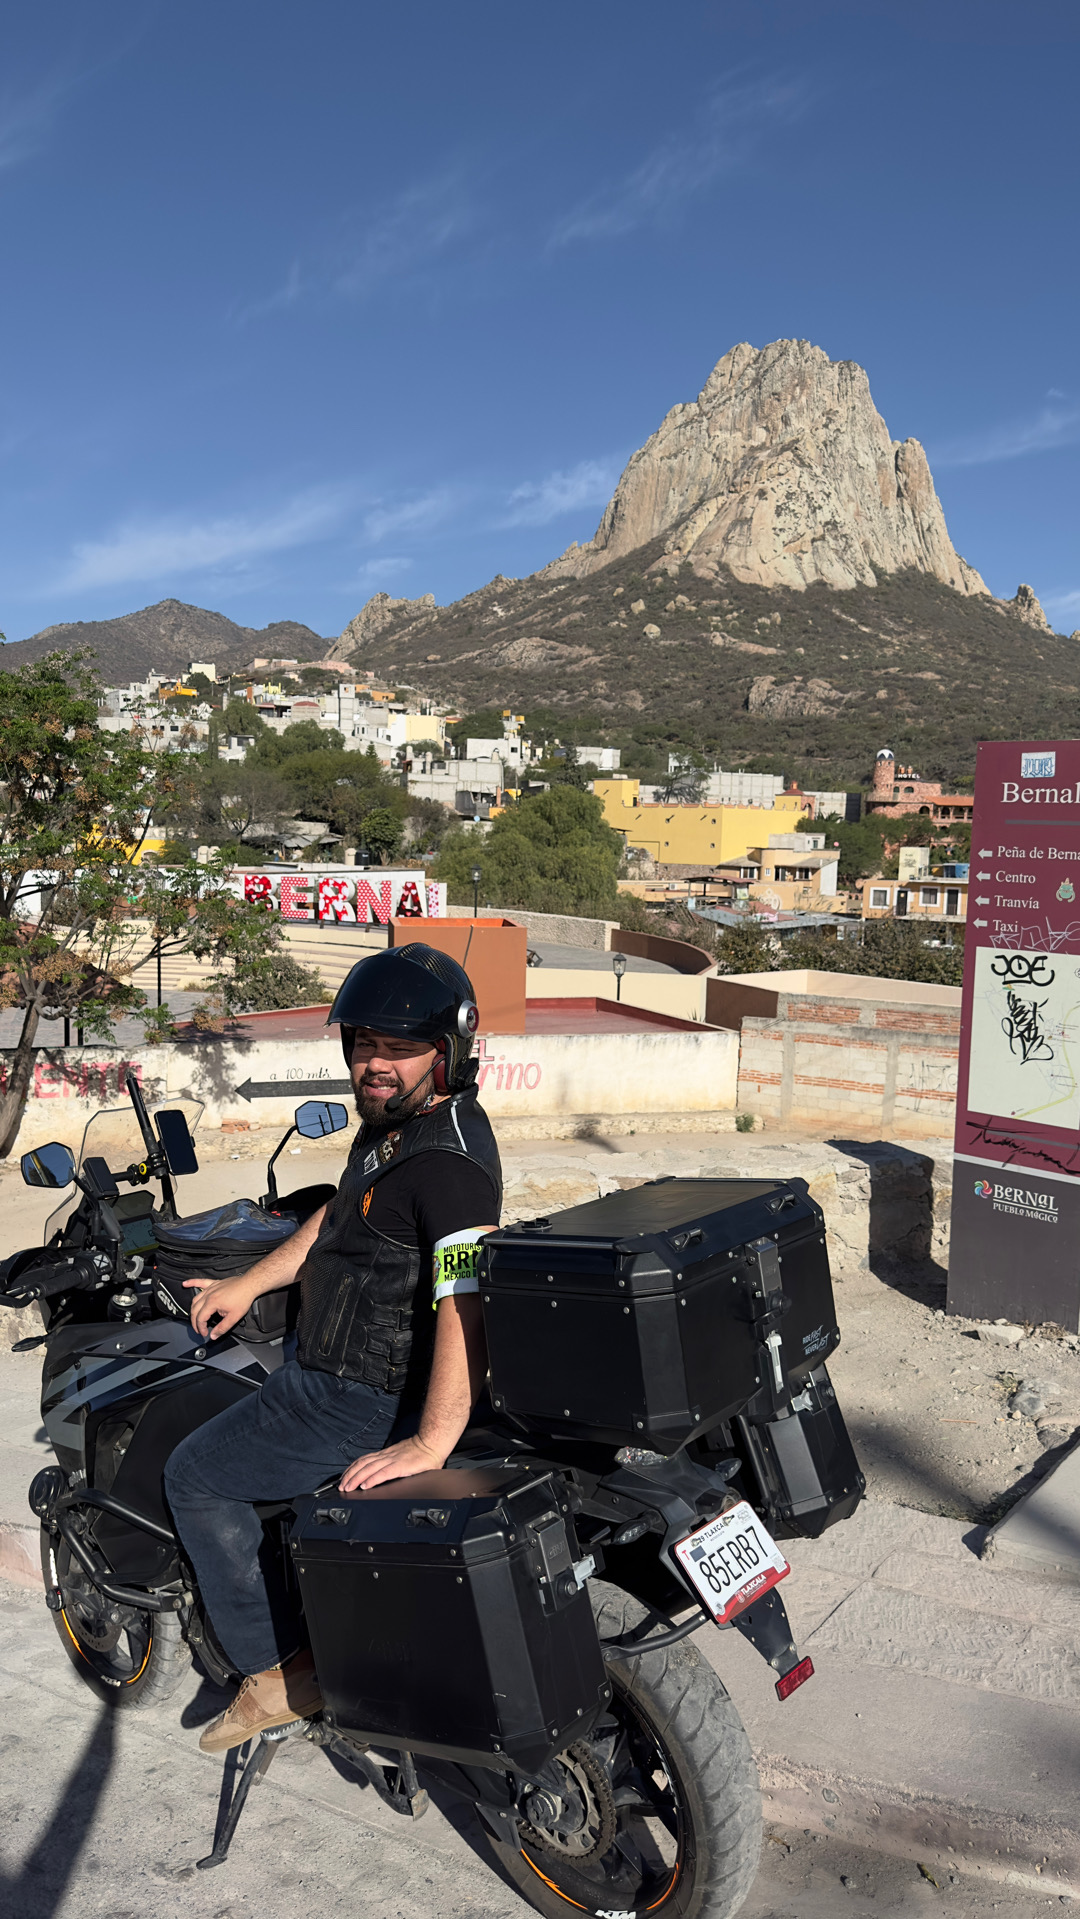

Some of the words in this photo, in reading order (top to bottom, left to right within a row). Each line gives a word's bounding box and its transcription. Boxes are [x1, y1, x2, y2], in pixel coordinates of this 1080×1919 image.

[1001, 781, 1080, 804] Bernal
[997, 846, 1026, 858] Peña
[1029, 847, 1044, 859] de
[995, 870, 1036, 884] Centro
[994, 895, 1039, 909] Tranvía
[993, 920, 1018, 932] Taxi
[286, 1068, 303, 1080] 100
[700, 1525, 768, 1593] 85ERB7
[740, 1574, 767, 1595] TLAXCALA
